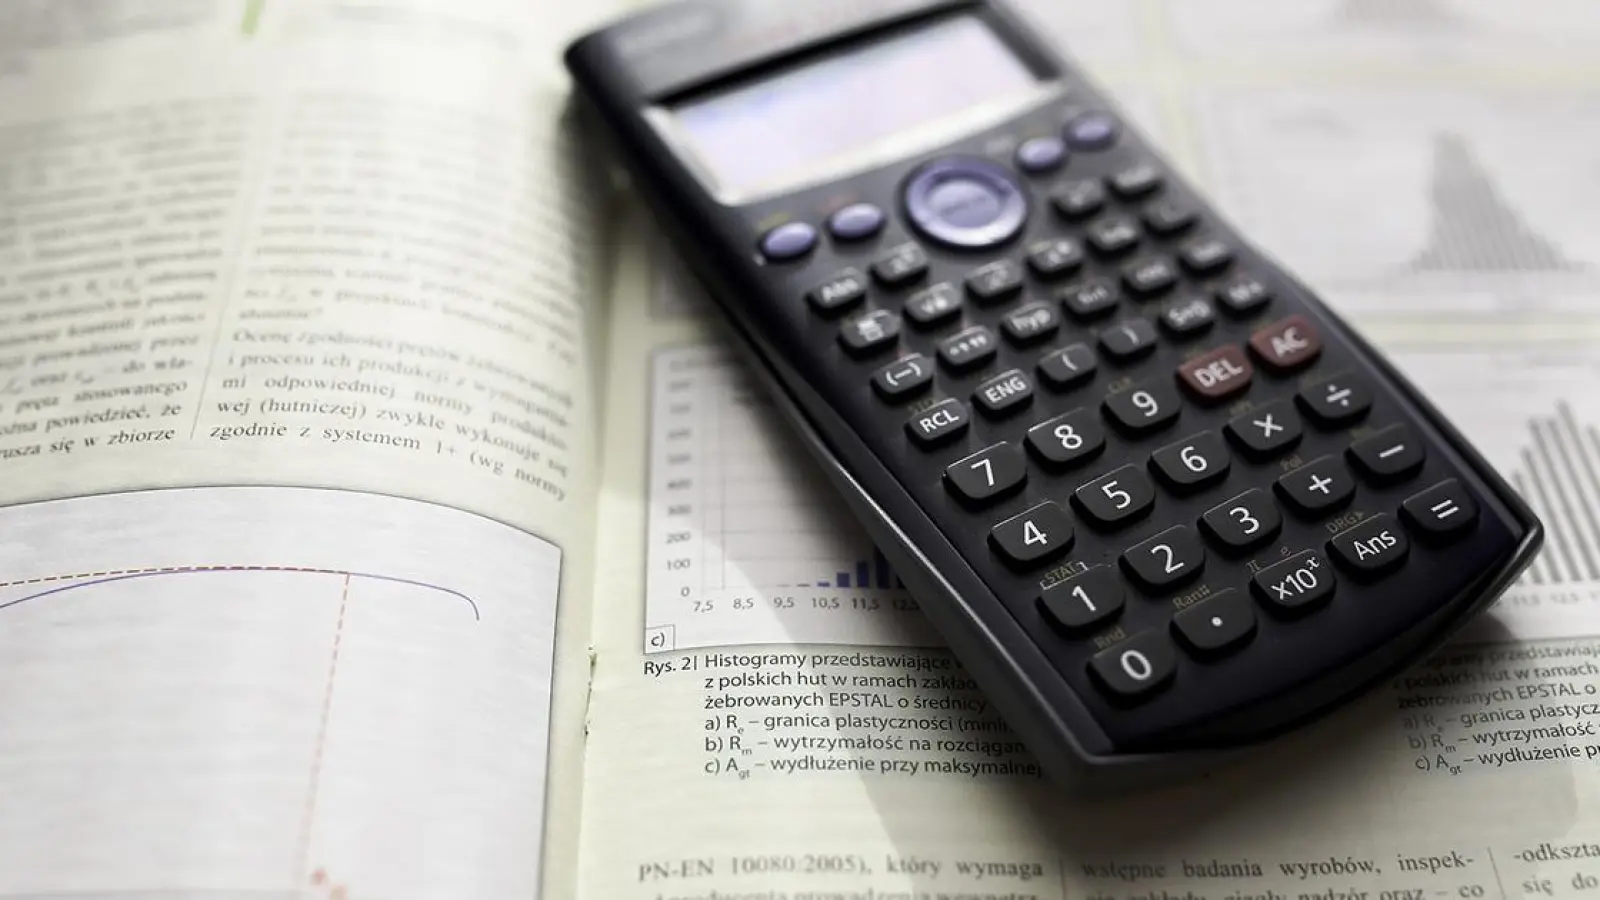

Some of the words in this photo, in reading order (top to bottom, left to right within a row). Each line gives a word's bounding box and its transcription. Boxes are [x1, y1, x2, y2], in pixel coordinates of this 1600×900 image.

[1271, 326, 1308, 358] AC
[240, 352, 315, 369] procesu
[323, 354, 351, 368] ich
[1193, 357, 1243, 388] DEL
[264, 375, 397, 400] odpowiedniej
[414, 389, 474, 416] normy
[984, 376, 1027, 404] ENG
[1131, 390, 1159, 417] 9
[218, 399, 251, 416] wej
[259, 397, 368, 420] (hutniczej)
[377, 407, 446, 431] zwykle
[455, 421, 541, 462] wykonuje
[919, 408, 959, 434] RCL
[49, 435, 75, 454] się
[84, 437, 98, 447] w
[107, 428, 176, 446] zbiorze
[1053, 423, 1084, 450] 8
[209, 422, 288, 442] zgodnie
[300, 427, 311, 438] z
[322, 426, 421, 451] systemem
[469, 451, 505, 477] (wg
[515, 467, 567, 503] normy
[970, 458, 996, 487] 7
[1179, 445, 1209, 473] 6
[1100, 480, 1132, 510] 5
[1022, 519, 1049, 546] 4
[1229, 506, 1260, 535] 3
[666, 531, 692, 545] 200
[1352, 528, 1398, 561] Ans
[666, 559, 691, 571] 100
[1043, 560, 1083, 583] STAT
[1150, 543, 1186, 575] 2
[680, 587, 691, 598] 0
[692, 600, 714, 613] 7,5
[732, 597, 755, 610] 8,5
[773, 597, 796, 610] 9,5
[811, 596, 841, 611] 10,5
[852, 598, 880, 612] 11,5
[1071, 584, 1097, 612] 1
[650, 632, 666, 647] c)
[643, 660, 677, 677] Rys.
[705, 653, 807, 673] Histogramy
[811, 652, 951, 673] przedstawiające
[1119, 648, 1153, 681] 0
[1515, 668, 1530, 680] w
[1534, 660, 1598, 678] ramach
[705, 677, 714, 689] z
[719, 672, 793, 691] polskich
[797, 672, 828, 687] hut
[833, 676, 849, 688] w
[852, 673, 917, 689] ramach
[1516, 682, 1581, 700] EPSTAL
[1584, 683, 1598, 695] o
[705, 692, 824, 712] żebrowanych
[829, 693, 894, 709] EPSTAL
[898, 697, 910, 709] o
[914, 694, 987, 714] średnicy
[705, 716, 721, 732] a)
[764, 714, 831, 732] granica
[835, 713, 954, 733] plastyczności
[1403, 715, 1419, 730] a)
[1461, 707, 1525, 729] granica
[705, 736, 723, 752] b)
[774, 734, 904, 754] wytrzymałość
[910, 740, 931, 751] na
[1408, 734, 1427, 750] b)
[1472, 719, 1597, 748] wytrzymałość
[705, 757, 721, 775] c)
[771, 754, 876, 776] wydłużenie
[880, 759, 919, 777] przy
[925, 759, 1042, 779] maksymalnej
[1415, 755, 1432, 772] c)
[1478, 743, 1581, 769] wydłużenie
[638, 856, 715, 884] PN-EN
[886, 853, 943, 881] który
[955, 860, 1044, 881] wymaga
[1083, 859, 1167, 883] wstępne
[1182, 858, 1264, 879] badania
[1279, 856, 1382, 881] wyrobów,
[1397, 849, 1475, 876] inspek-
[1459, 884, 1486, 899] co
[1522, 875, 1554, 897] się
[1571, 872, 1600, 892] do
